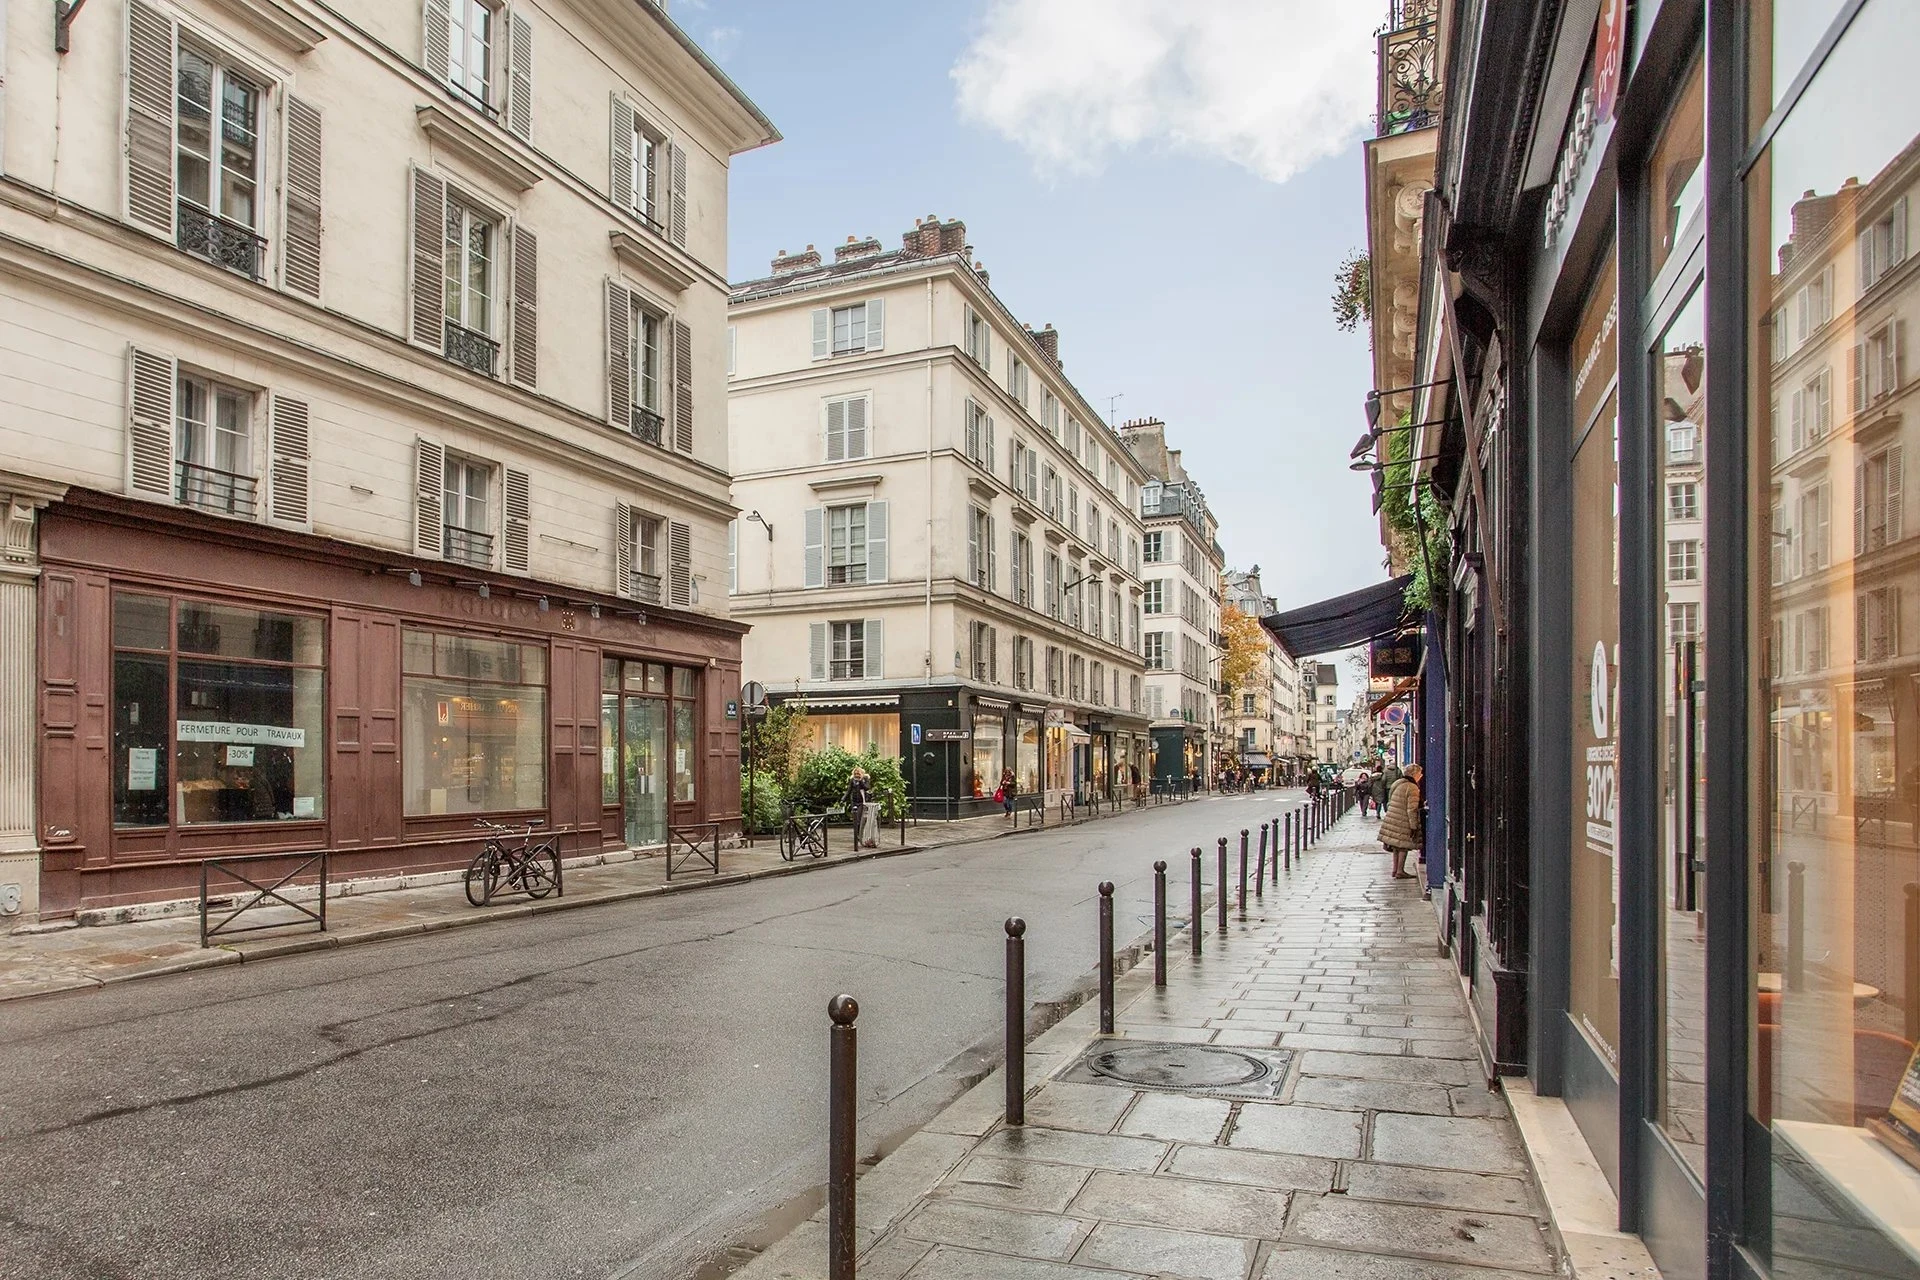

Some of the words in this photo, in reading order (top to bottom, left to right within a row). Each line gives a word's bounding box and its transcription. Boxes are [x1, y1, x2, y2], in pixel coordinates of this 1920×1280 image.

[180, 724, 231, 735] FERMETURE
[236, 727, 259, 737] POUR
[267, 728, 302, 740] TRAVAUX
[1586, 765, 1615, 822] 3012
